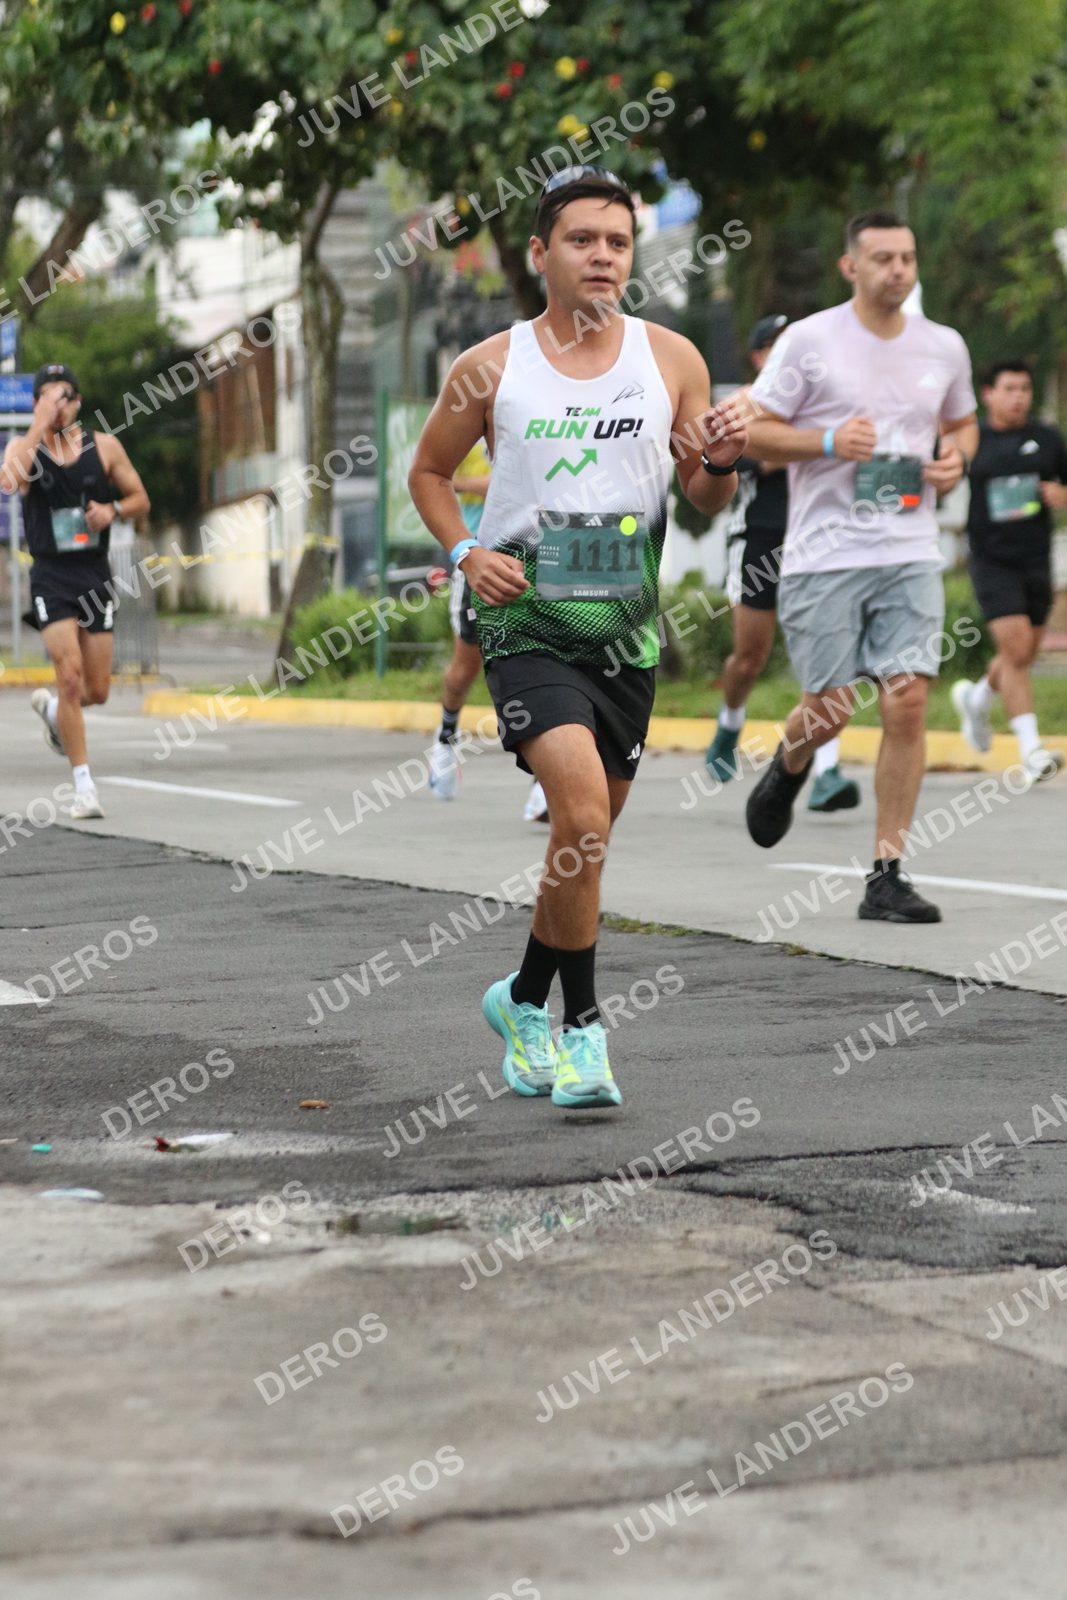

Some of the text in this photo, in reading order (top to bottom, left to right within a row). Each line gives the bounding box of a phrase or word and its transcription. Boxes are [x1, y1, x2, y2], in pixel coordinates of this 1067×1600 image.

[565, 407, 602, 416] TEAM
[524, 418, 644, 439] RUN UP!
[566, 538, 640, 572] 1111
[572, 589, 609, 597] SAMSUNG
